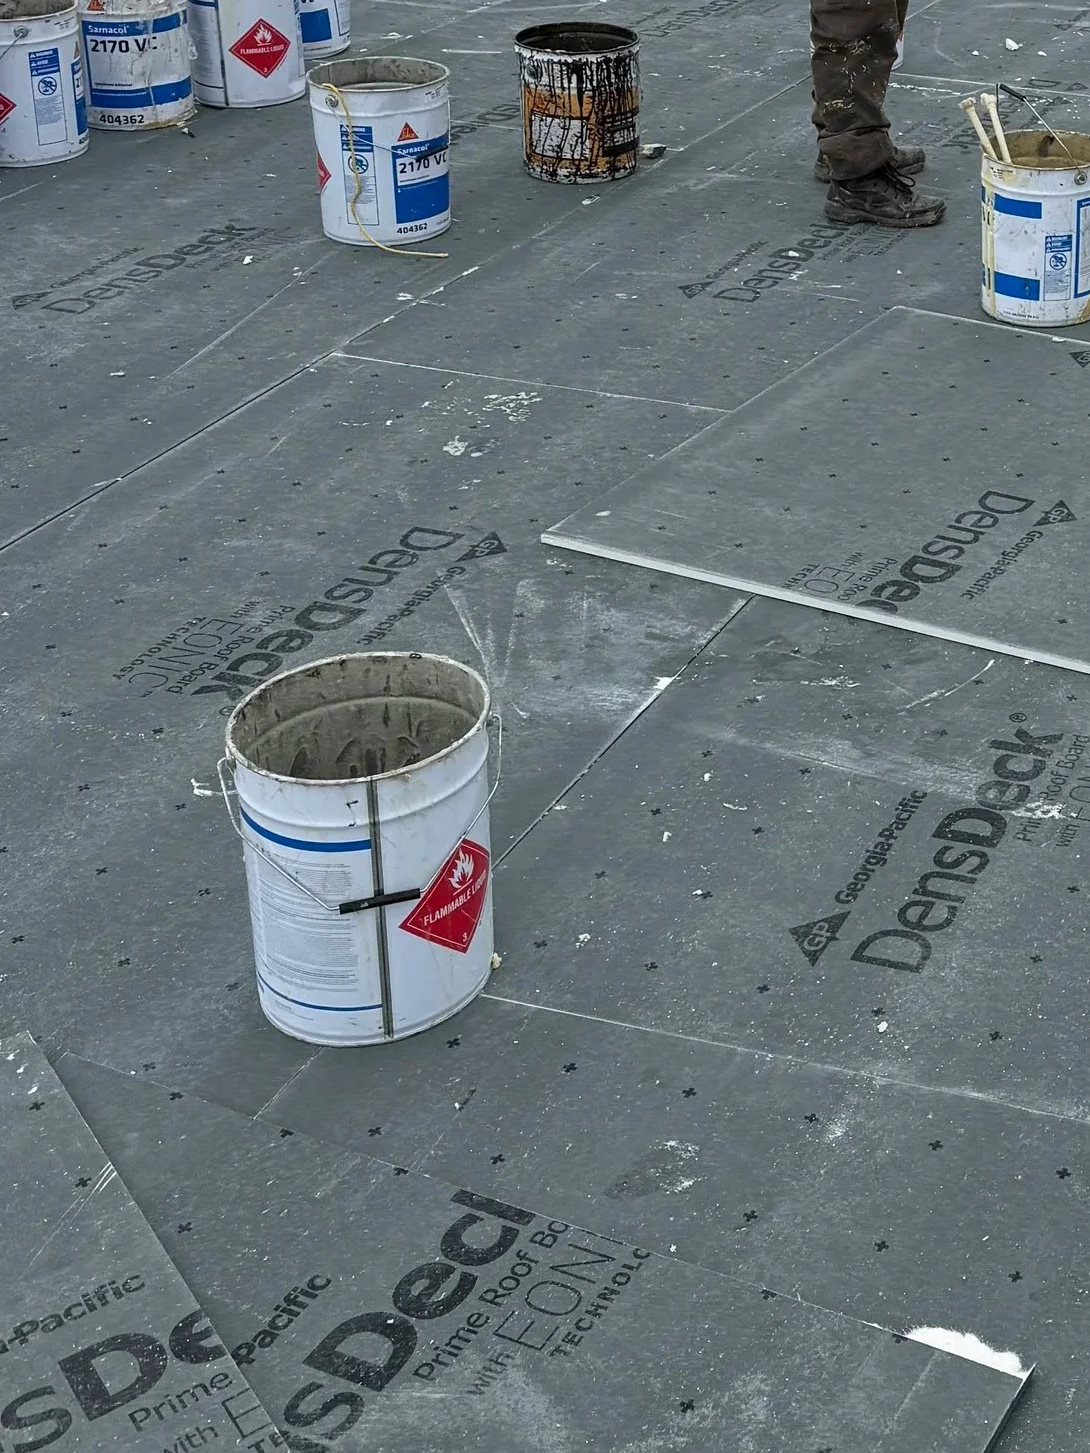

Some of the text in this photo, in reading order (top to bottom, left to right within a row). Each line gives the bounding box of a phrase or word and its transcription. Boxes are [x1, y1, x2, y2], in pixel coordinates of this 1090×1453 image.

[88, 25, 130, 35] Sarnacol
[90, 38, 130, 54] 2170
[99, 113, 145, 126] 404362
[399, 158, 430, 174] 2170
[396, 222, 428, 235] 404362
[1049, 507, 1069, 524] GP
[473, 538, 500, 558] GP
[782, 562, 820, 591] TECHN
[804, 565, 855, 594] EO
[837, 557, 899, 602] Prime Roo
[112, 615, 208, 681] TECHNOLOGY
[165, 603, 296, 696] Prime Roof Board
[835, 789, 928, 905] Georgia-Pacific
[1055, 823, 1080, 848] with
[423, 891, 471, 927] FLAMMABLE
[802, 920, 829, 953] GP
[412, 1311, 491, 1383] Prime
[478, 1249, 540, 1308] Roof
[549, 1248, 652, 1358] TECHNOLO
[466, 1350, 519, 1397] with
[127, 1369, 235, 1433] Prime
[221, 1385, 276, 1441] E
[247, 1430, 292, 1453] TE
